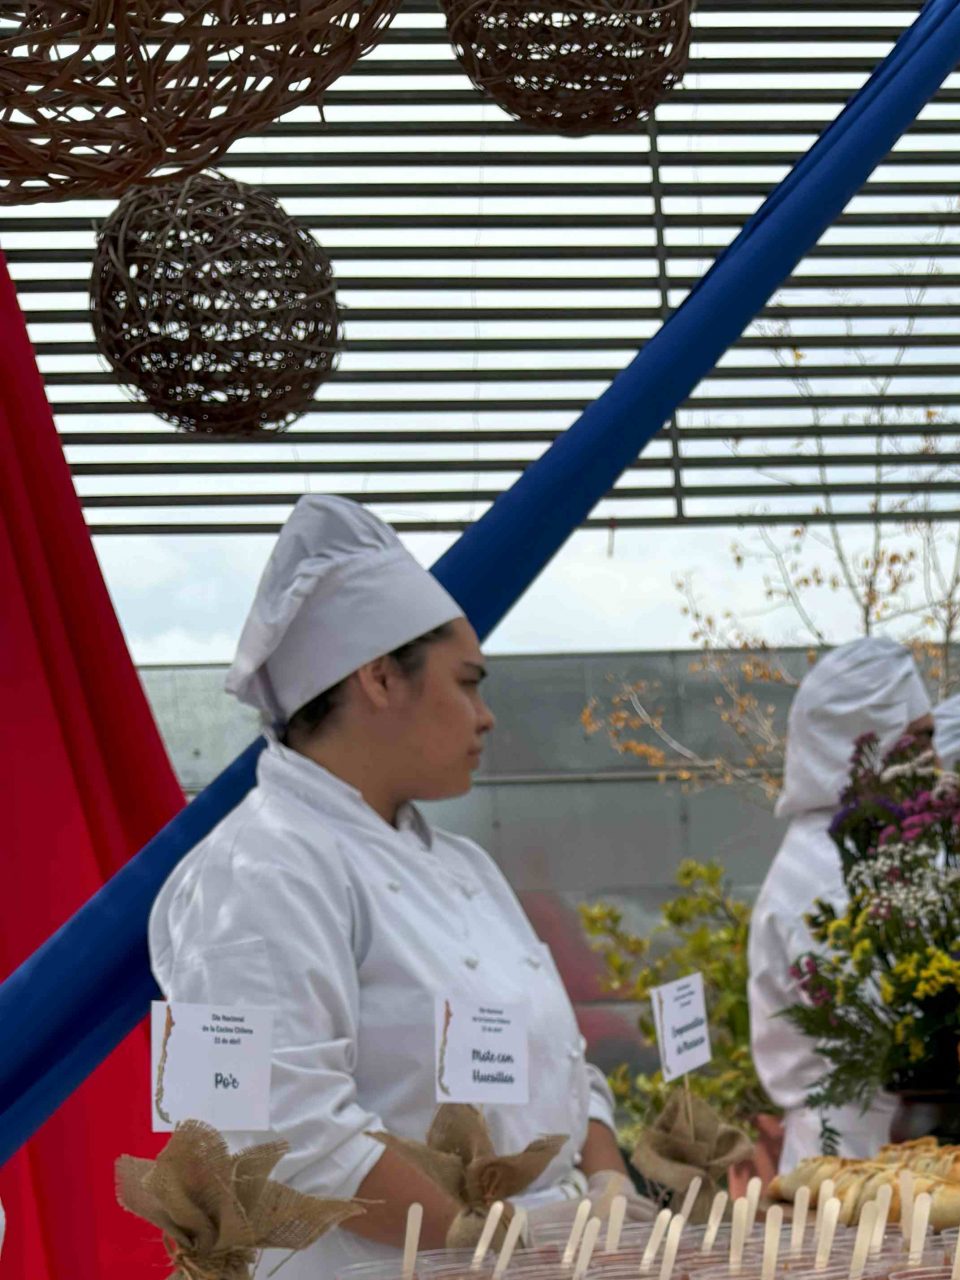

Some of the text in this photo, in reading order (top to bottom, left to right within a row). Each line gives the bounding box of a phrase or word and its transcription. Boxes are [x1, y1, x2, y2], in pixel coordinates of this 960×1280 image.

[222, 1014, 245, 1022] Nacional
[216, 1025, 233, 1033] Cocina
[234, 1026, 253, 1034] Chilena
[229, 1037, 242, 1045] abril
[472, 1048, 515, 1063] Mote con
[472, 1068, 515, 1084] Huesillos
